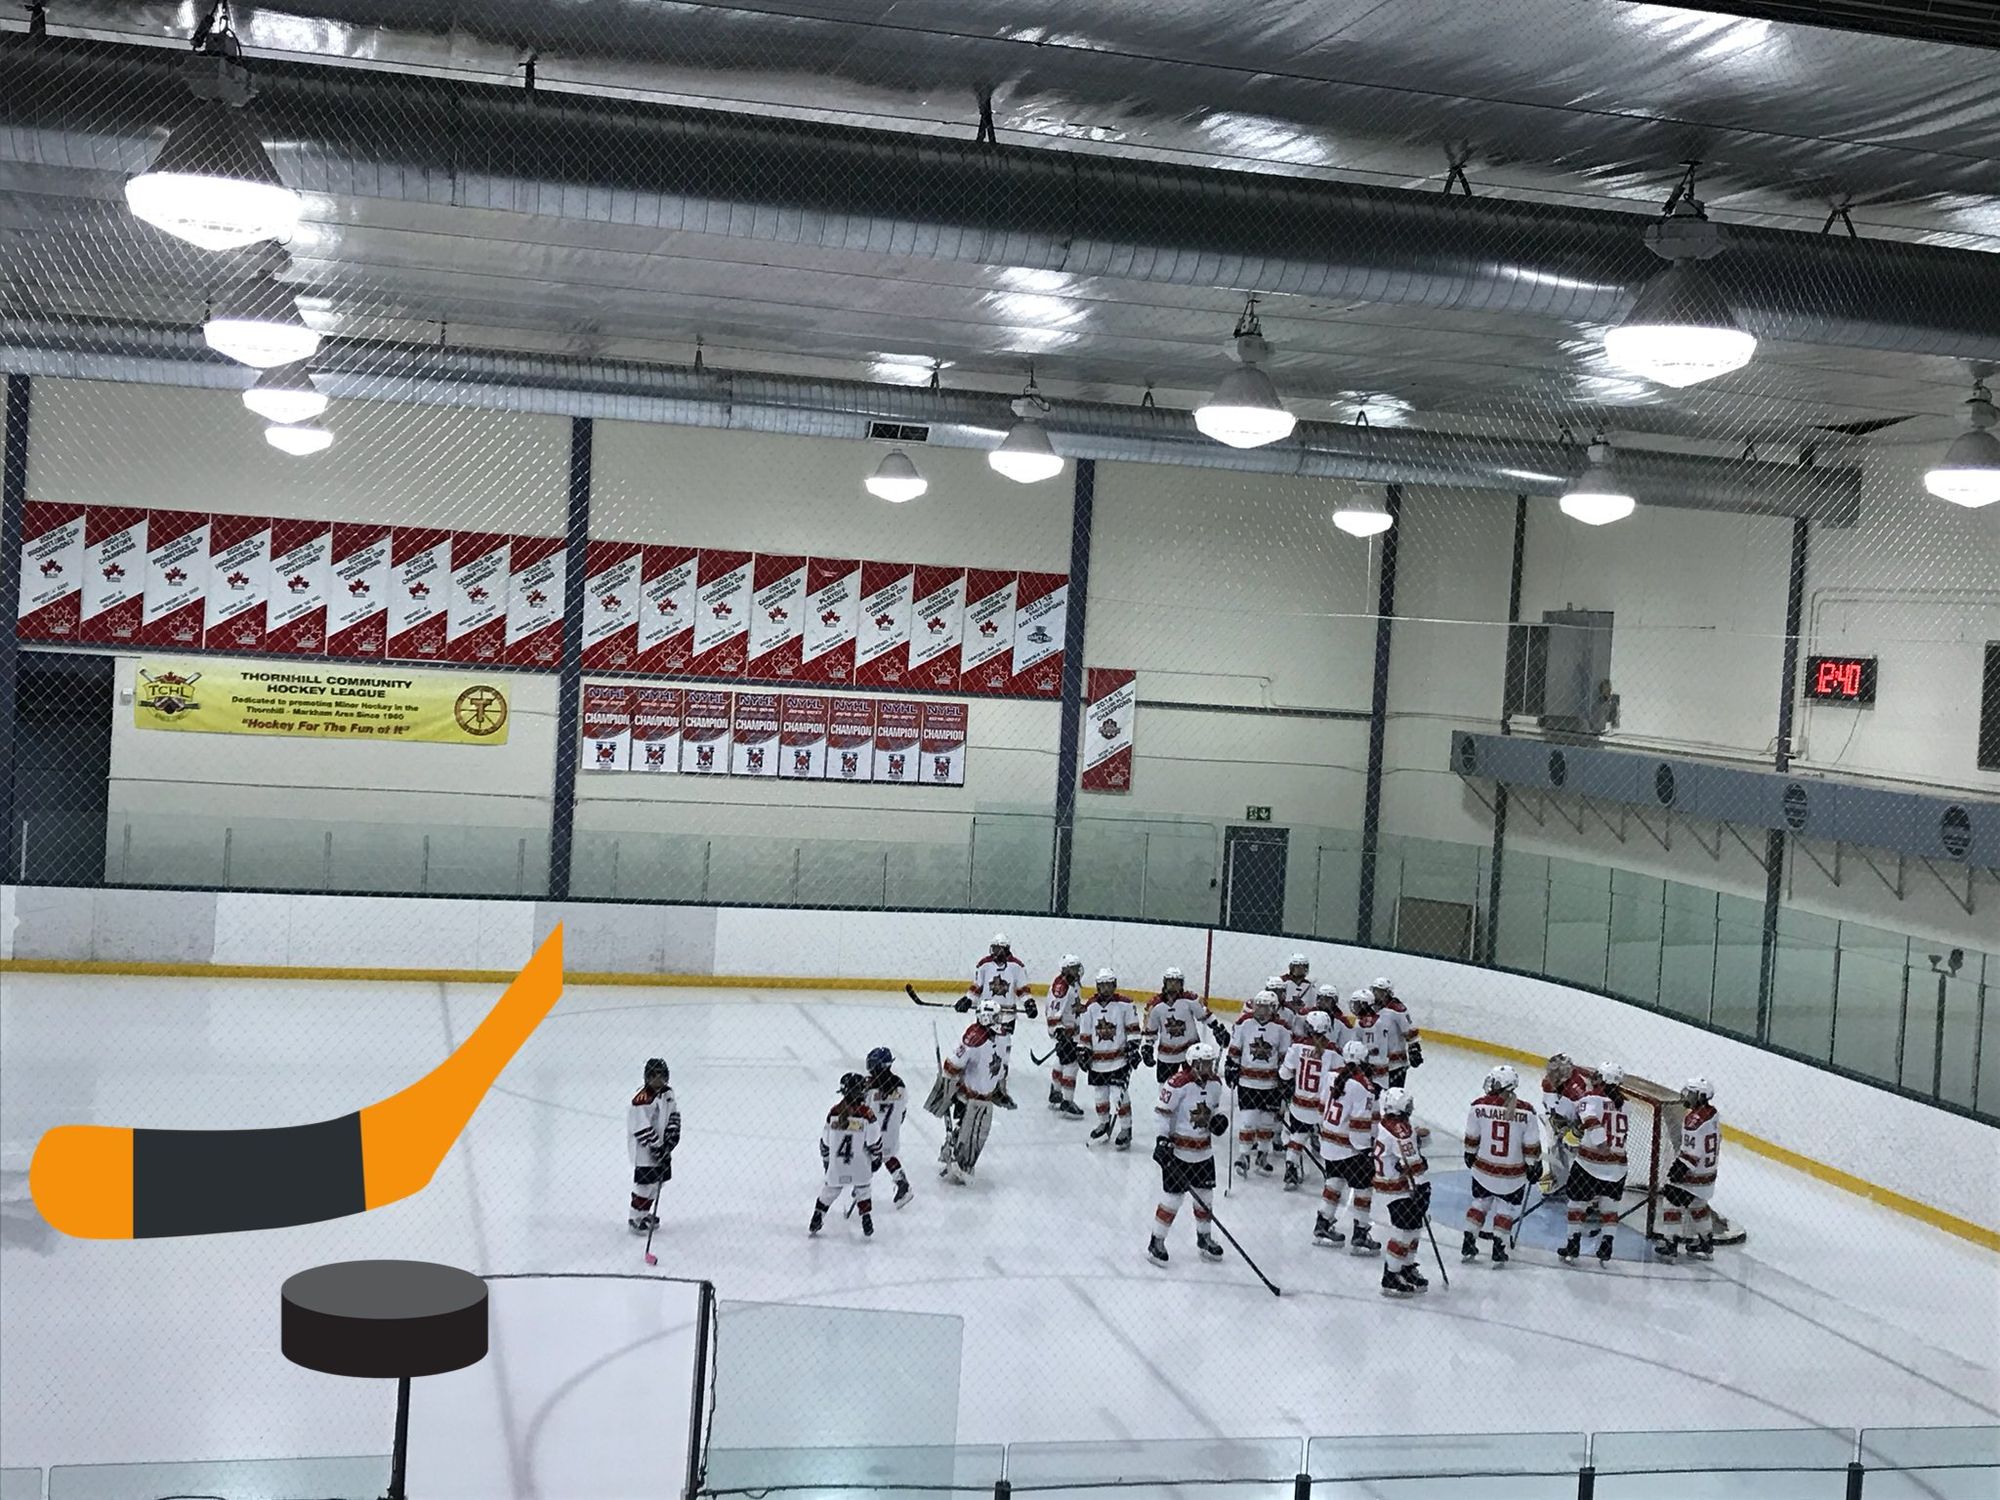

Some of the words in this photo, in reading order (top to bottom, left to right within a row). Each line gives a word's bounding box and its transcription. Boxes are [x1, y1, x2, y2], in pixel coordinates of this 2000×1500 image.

[241, 672, 322, 684] THORNHILL
[326, 676, 412, 689] COMMUNITY
[149, 685, 188, 698] TCHL
[267, 685, 327, 695] HOCKEY
[330, 688, 386, 698] LEAGUE
[589, 688, 629, 699] NYHL
[639, 690, 678, 701] NYHL
[689, 692, 727, 704] NYHL
[231, 696, 276, 705] Dedicated
[289, 699, 333, 708] promoting
[335, 701, 359, 709] Minor
[361, 703, 392, 712] Hockey
[739, 695, 777, 706] NYHL
[786, 698, 824, 709] NYHL
[833, 700, 871, 712] NYHL
[246, 706, 285, 715] Thornhill
[293, 708, 333, 717] Markham
[356, 711, 380, 719] Since
[880, 702, 917, 714] NYHL
[927, 704, 963, 716] NYHL
[1097, 699, 1133, 721] CHAMPIONS
[585, 712, 630, 725] CHAMPION
[634, 714, 680, 727] CHAMPION
[685, 716, 729, 729] CHAMPION
[735, 719, 778, 731] CHAMPION
[299, 721, 320, 731] For
[323, 722, 347, 732] The
[350, 723, 374, 733] Fun
[377, 725, 391, 734] of
[783, 721, 826, 734] CHAMPION
[830, 724, 872, 736] CHAMPION
[877, 726, 919, 739] CHAMPION
[923, 729, 964, 741] CHAMPION
[1299, 1058, 1322, 1093] 16
[879, 1103, 894, 1132] 7
[1490, 1120, 1510, 1157] 9
[837, 1134, 854, 1165] 4
